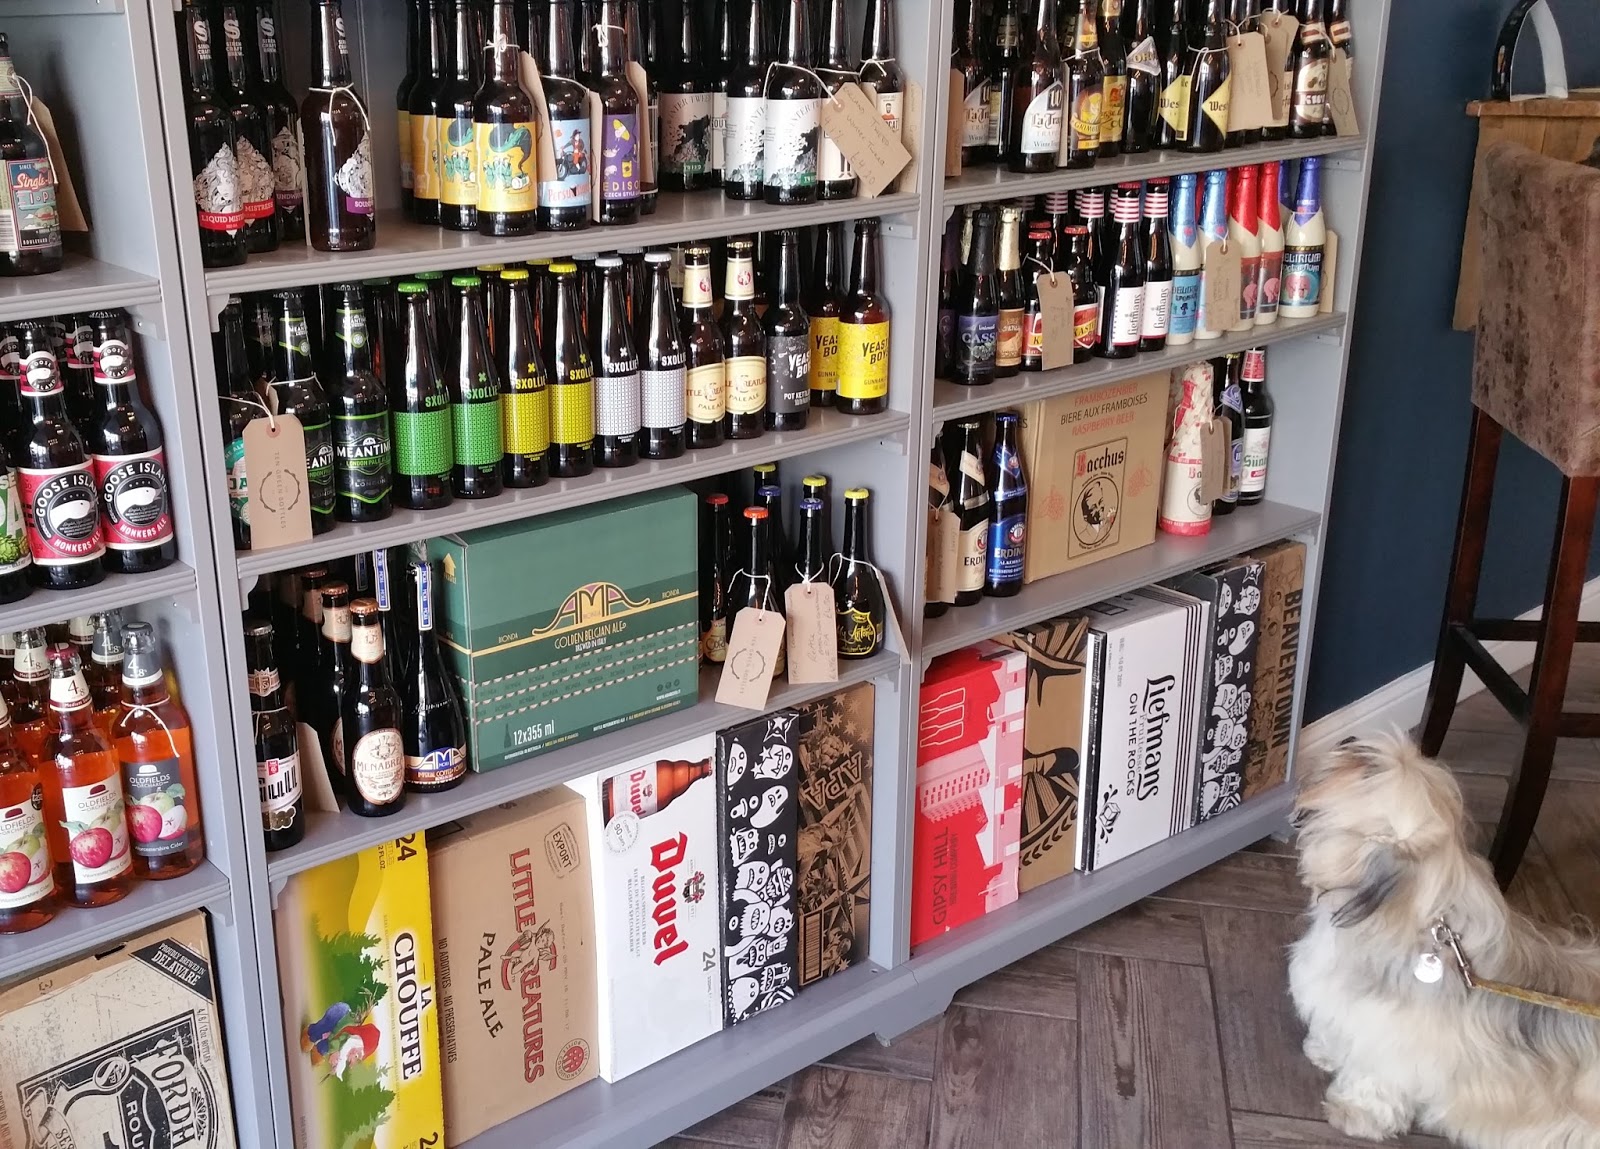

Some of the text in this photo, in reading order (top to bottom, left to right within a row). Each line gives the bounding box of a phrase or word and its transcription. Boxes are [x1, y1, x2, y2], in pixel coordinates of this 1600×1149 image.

[202, 214, 228, 223] LIQUID
[245, 202, 273, 212] MISTRESS
[1075, 383, 1138, 406] FRAMBOZENBIER
[1060, 393, 1148, 426] BIERE AUX FRAMBOISES
[1072, 411, 1135, 436] RASPBERRY BEER
[306, 451, 333, 469] EANT
[1076, 447, 1125, 477] Bacchus
[36, 477, 69, 517] GOOSE
[104, 463, 168, 502] GOOSE ISLAND
[120, 517, 167, 538] HONKERS ALE
[54, 539, 92, 552] HONKERS
[554, 621, 627, 649] GOLDEN BELGIAN ALE
[1272, 588, 1303, 748] BEAVERTOWN
[513, 722, 543, 746] 12x355
[544, 719, 555, 737] ml
[1126, 693, 1138, 796] ON THE ROCKS
[1137, 675, 1175, 801] Liefmans
[129, 774, 170, 784] OLDFIELDS
[630, 769, 647, 817] Duvel
[78, 790, 117, 809] OLDFIELDS
[0, 814, 36, 831] LDFIELDS
[613, 823, 623, 836] 90
[169, 841, 183, 849] Cider
[395, 833, 417, 861] 24
[552, 831, 572, 870] EXPORT
[932, 826, 948, 925] GIPSY HILL
[650, 831, 689, 967] Duvel
[151, 951, 201, 986] DELAWARE
[158, 943, 206, 975] PROUDLY BREWED IN
[500, 847, 558, 1084] LITTLE CREATURES
[703, 948, 716, 971] 24
[419, 986, 433, 1010] LA
[438, 937, 458, 1064] NO ADDITIVES NO PRESERVATIVES
[477, 932, 504, 1040] PALE ALE
[394, 932, 422, 1080] CHOUFFE
